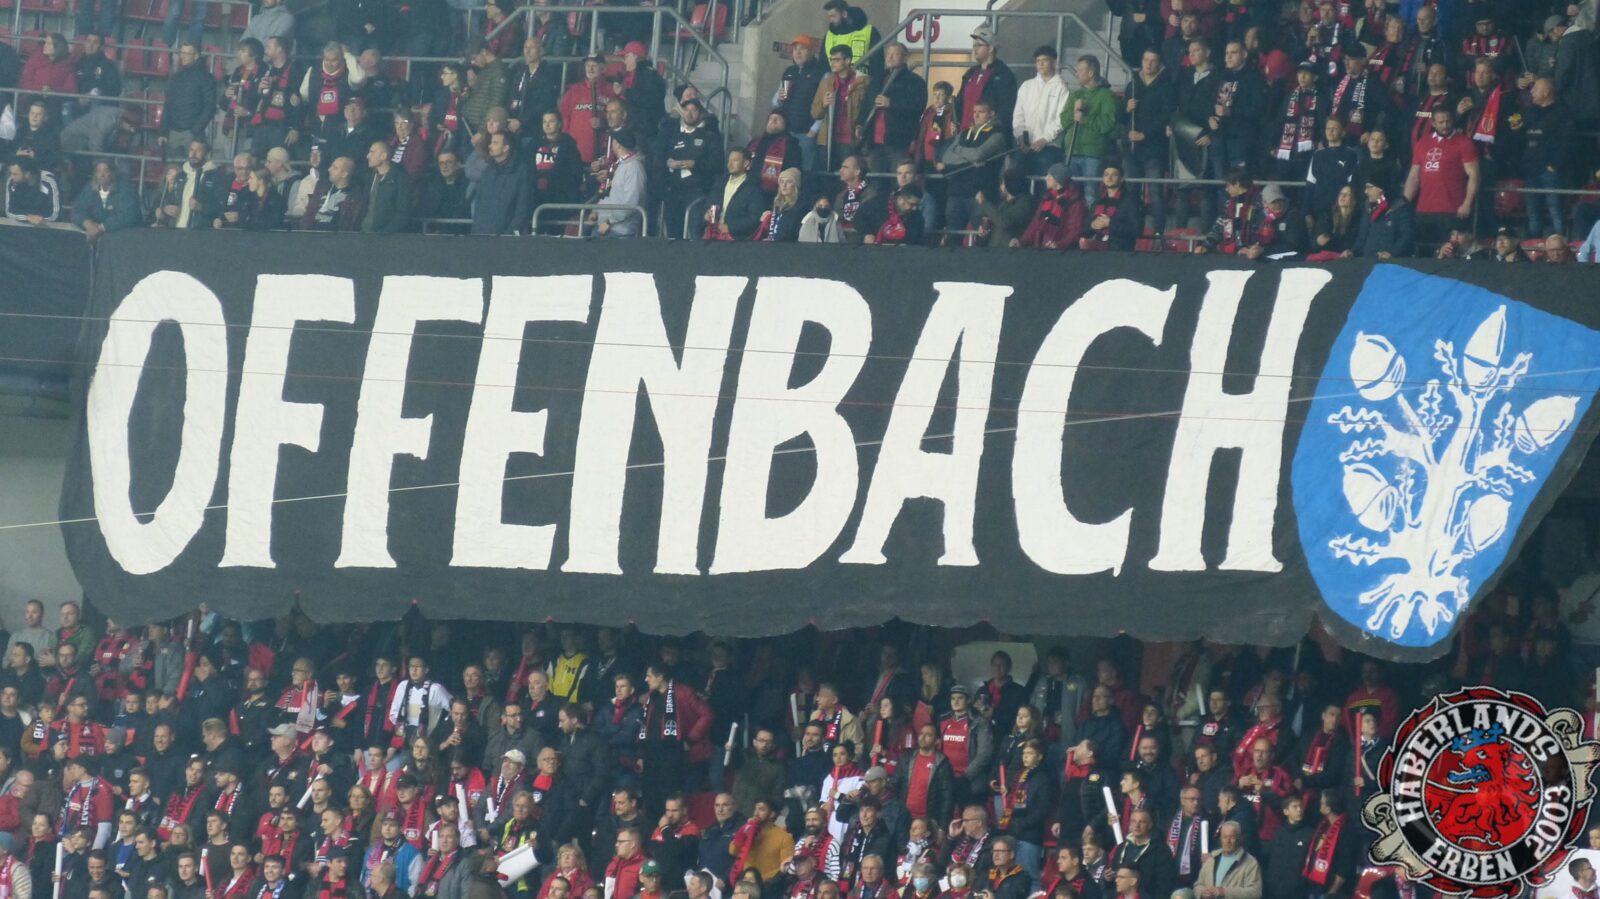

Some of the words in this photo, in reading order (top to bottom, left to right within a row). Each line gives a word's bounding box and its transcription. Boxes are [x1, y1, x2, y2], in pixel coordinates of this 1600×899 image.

[906, 9, 940, 43] C6
[1425, 161, 1440, 169] 04
[87, 268, 1333, 576] OFFENBACH
[663, 728, 678, 736] 04
